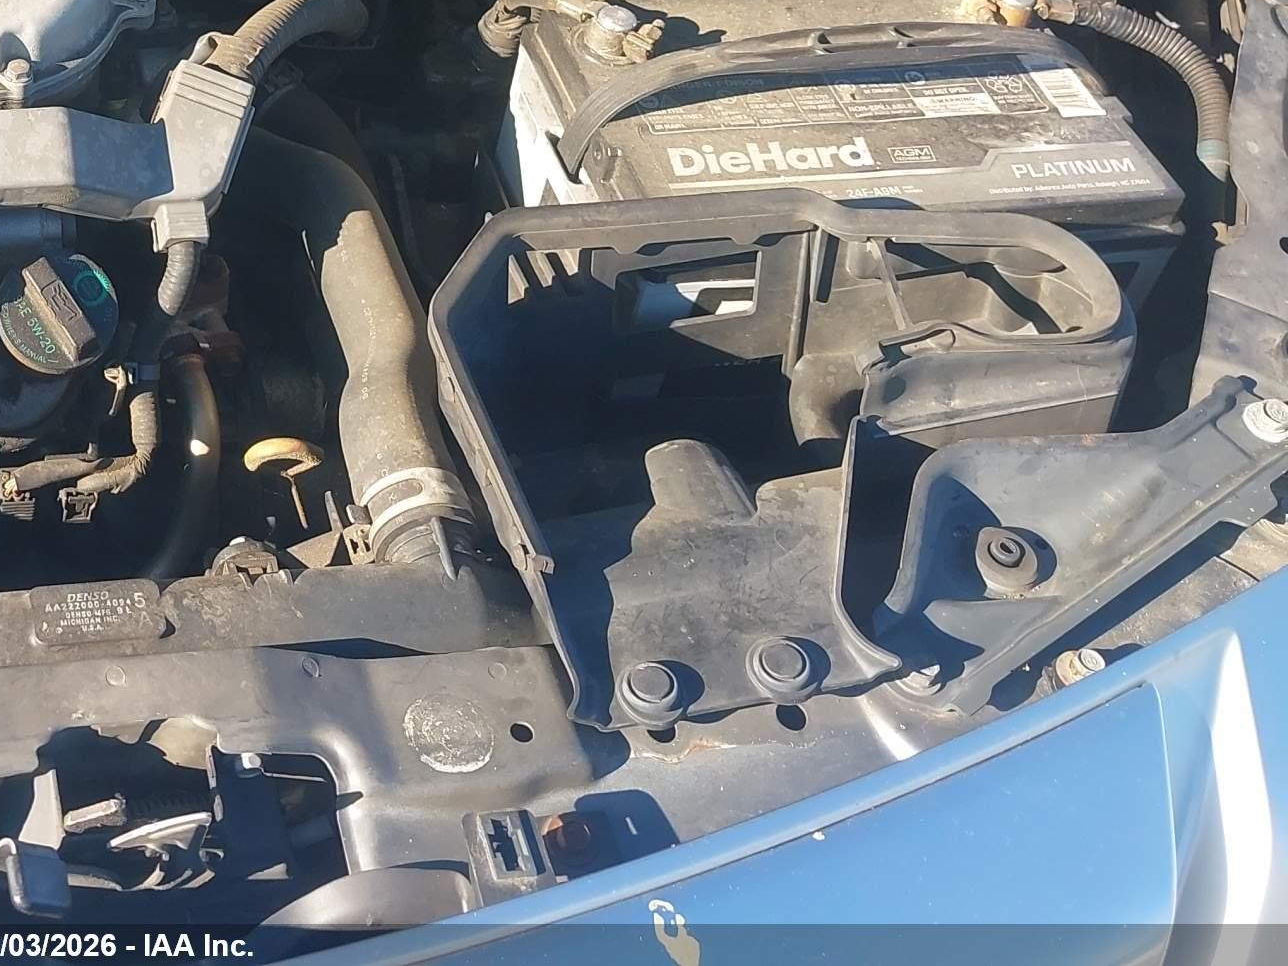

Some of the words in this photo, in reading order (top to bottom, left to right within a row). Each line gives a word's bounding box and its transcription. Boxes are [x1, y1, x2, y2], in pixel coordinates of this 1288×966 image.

[667, 137, 875, 177] DieHard
[893, 147, 930, 157] AGM
[1011, 158, 1136, 179] PLATINUM
[26, 317, 56, 354] 5W-20
[19, 343, 48, 364] MANUAL
[67, 590, 109, 603] DENSO
[133, 592, 146, 608] 5
[60, 616, 101, 626] MICHIGAN
